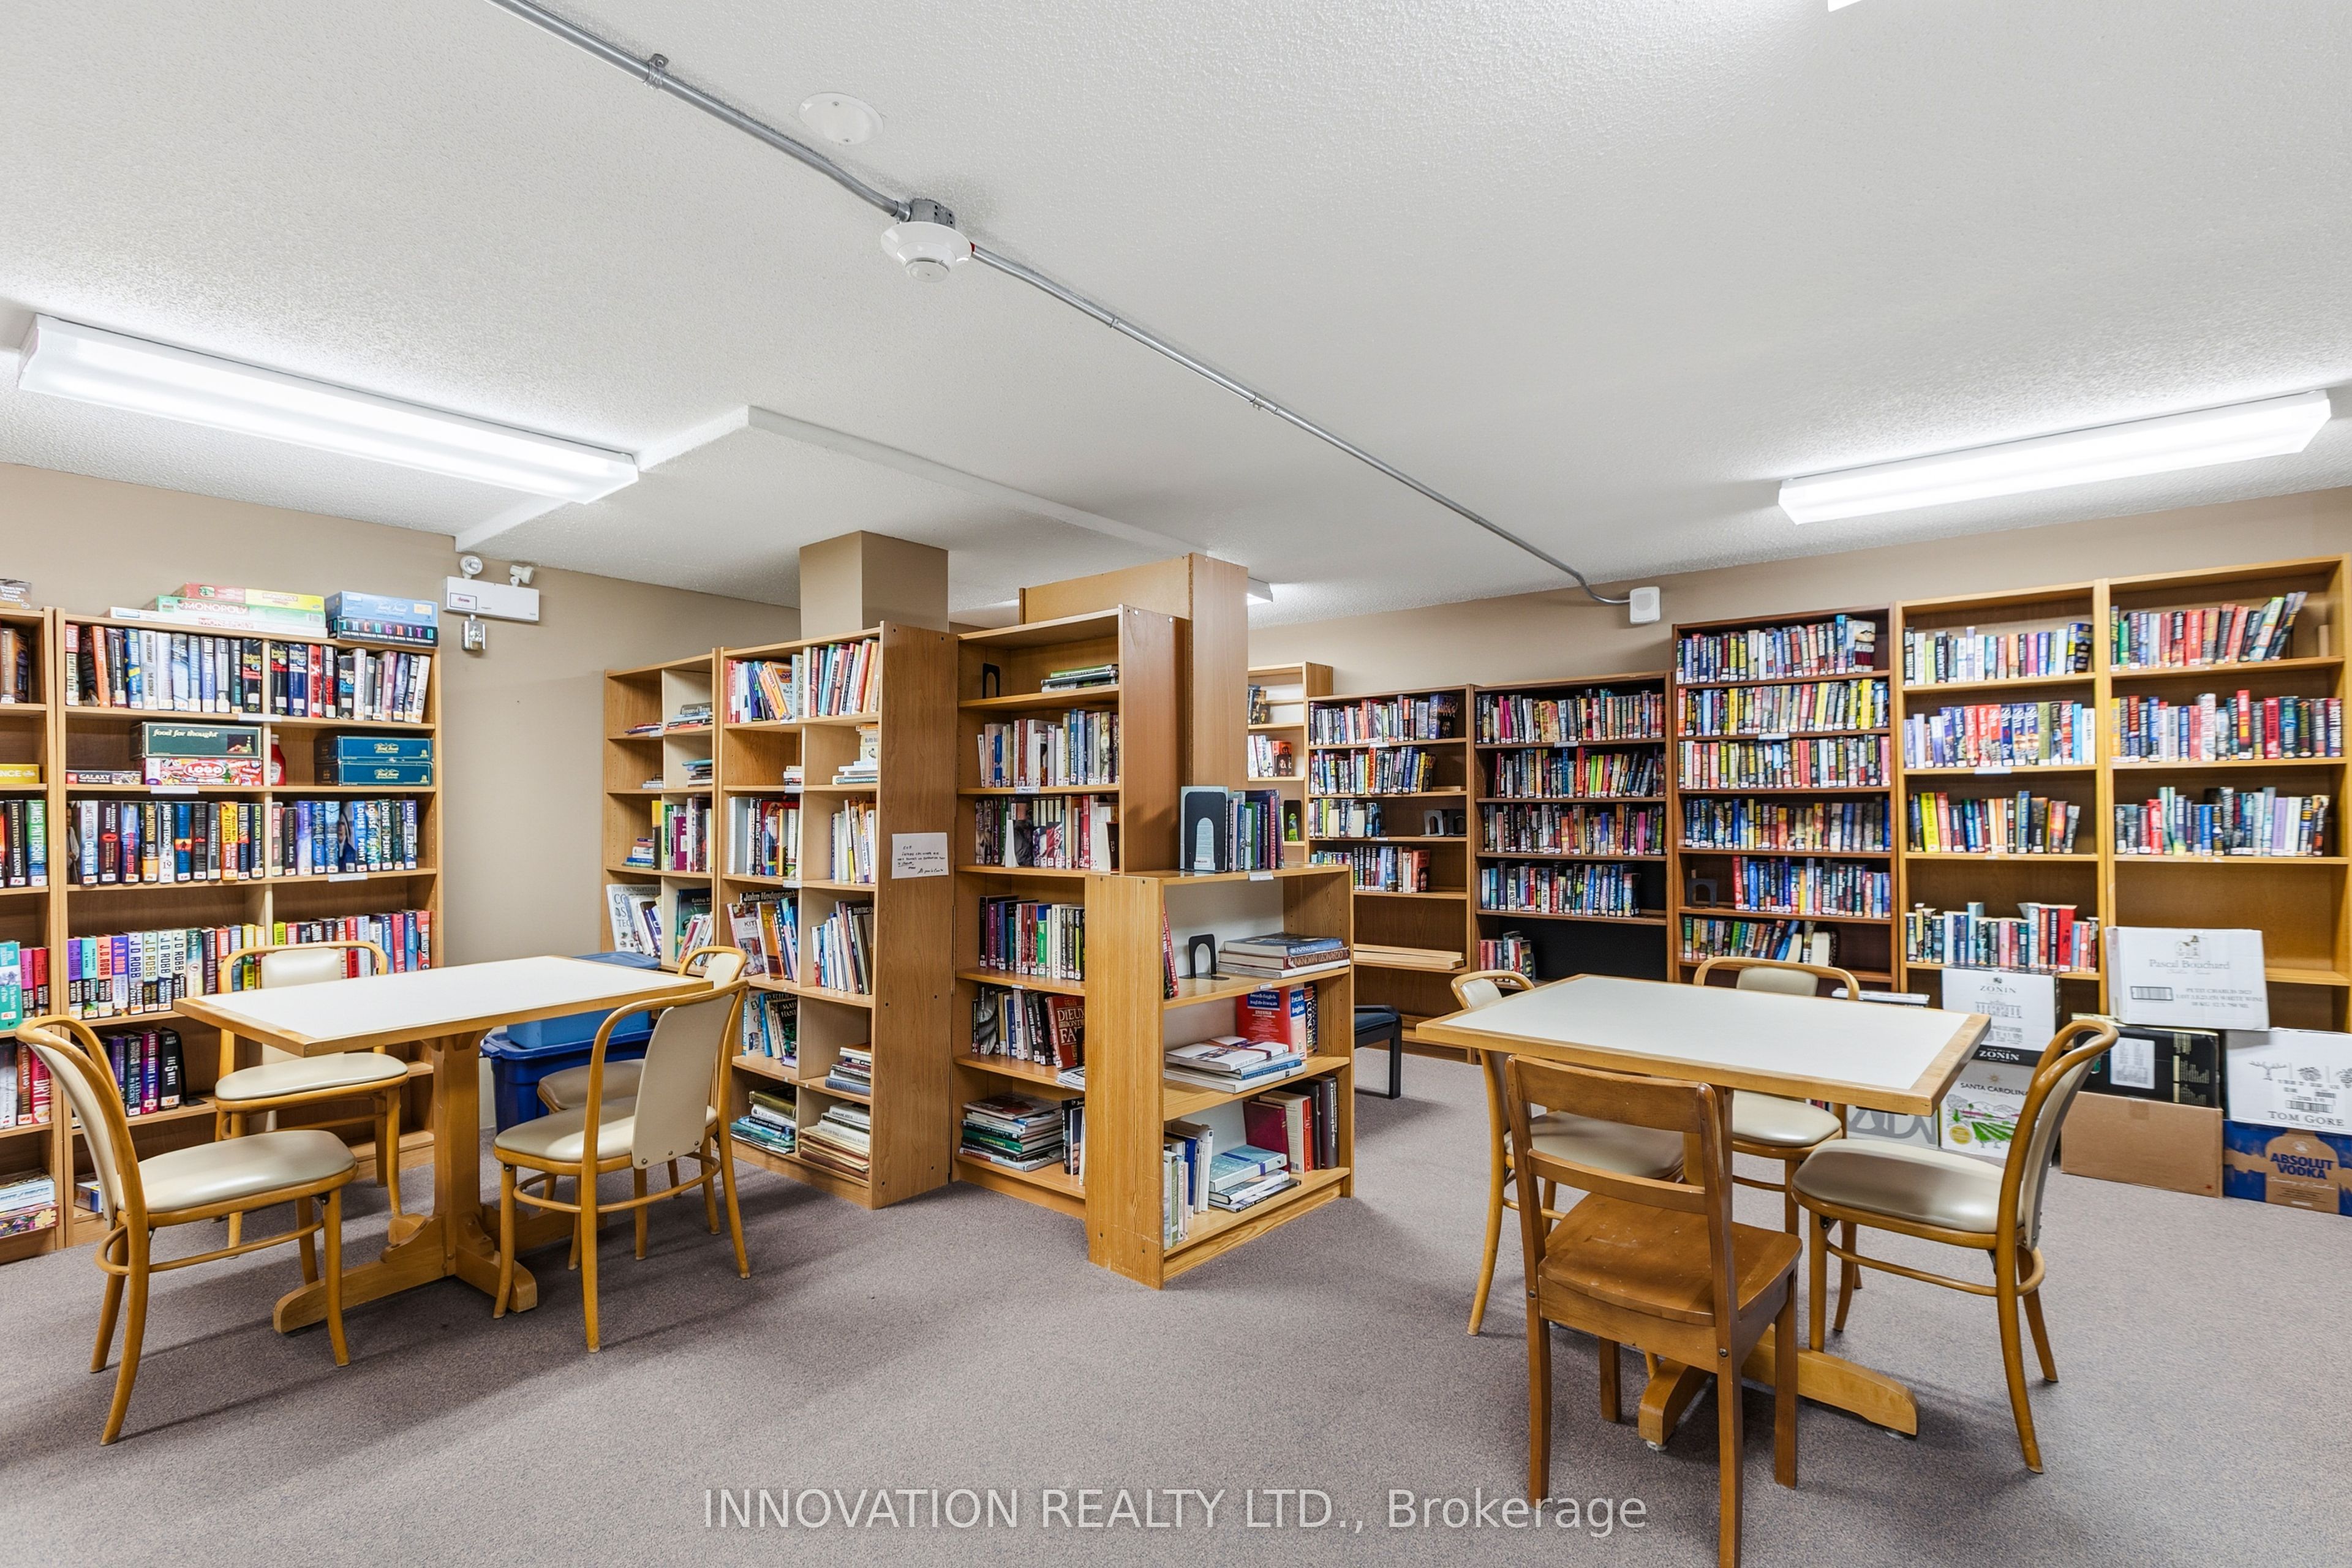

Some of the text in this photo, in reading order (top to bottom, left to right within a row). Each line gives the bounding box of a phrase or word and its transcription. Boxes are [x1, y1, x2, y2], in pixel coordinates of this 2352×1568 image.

[184, 602, 247, 614] MONOPOLY
[2329, 706, 2342, 748] SCOTT TUROW
[187, 766, 222, 775] LOGO
[31, 804, 43, 861] JAMES PATTERSON
[162, 805, 172, 850] JAMES PATTERSON
[382, 836, 391, 859] PENNY
[744, 894, 760, 902] John
[312, 924, 322, 941] JOHN
[100, 959, 110, 975] ROBB
[114, 957, 125, 973] ROBB
[131, 957, 141, 978] ROBB
[146, 956, 156, 977] ROBB
[161, 954, 171, 973] ROBB
[175, 952, 184, 970] ROBB
[2149, 959, 2230, 970] Pascal Bouchard
[1980, 985, 2017, 993] ZONIN
[1979, 1050, 2019, 1061] ZONIN
[167, 1072, 176, 1085] WAVE
[1960, 1082, 1986, 1091] SANTA
[34, 1080, 49, 1098] DRY
[2268, 1110, 2345, 1126] TOM GORE
[2270, 1153, 2335, 1170] ABSOLUT
[2277, 1164, 2327, 1180] VODKA
